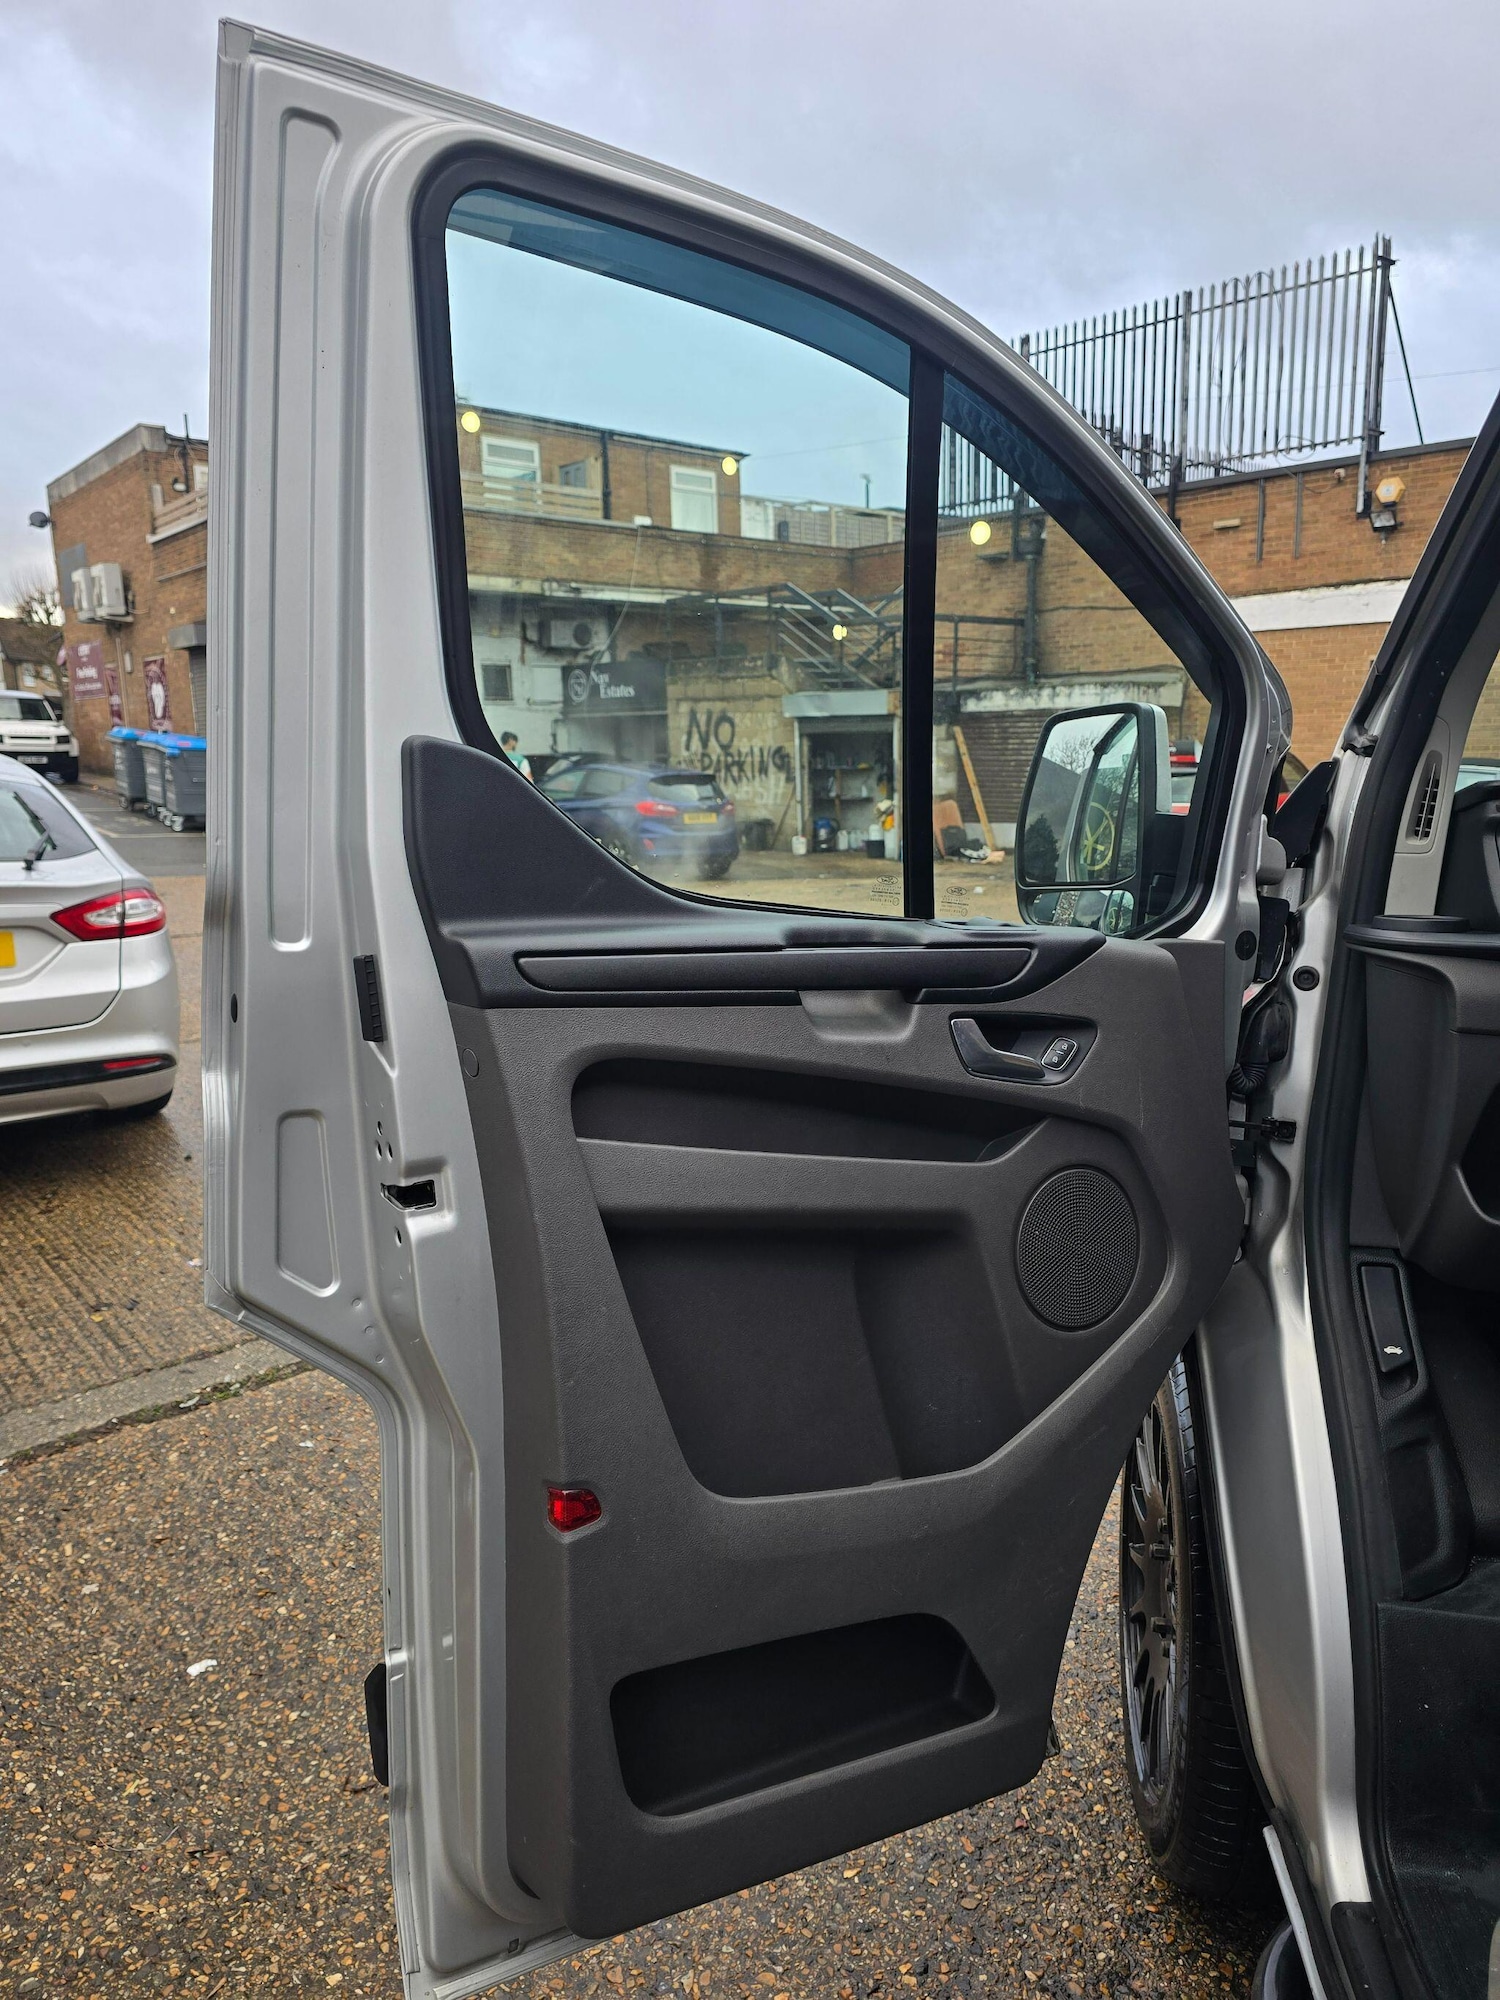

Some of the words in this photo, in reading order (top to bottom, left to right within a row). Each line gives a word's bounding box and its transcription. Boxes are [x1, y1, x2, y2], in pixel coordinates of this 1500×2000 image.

[600, 684, 635, 699] Estates
[685, 706, 735, 750] NO
[700, 745, 795, 785] PARKING
